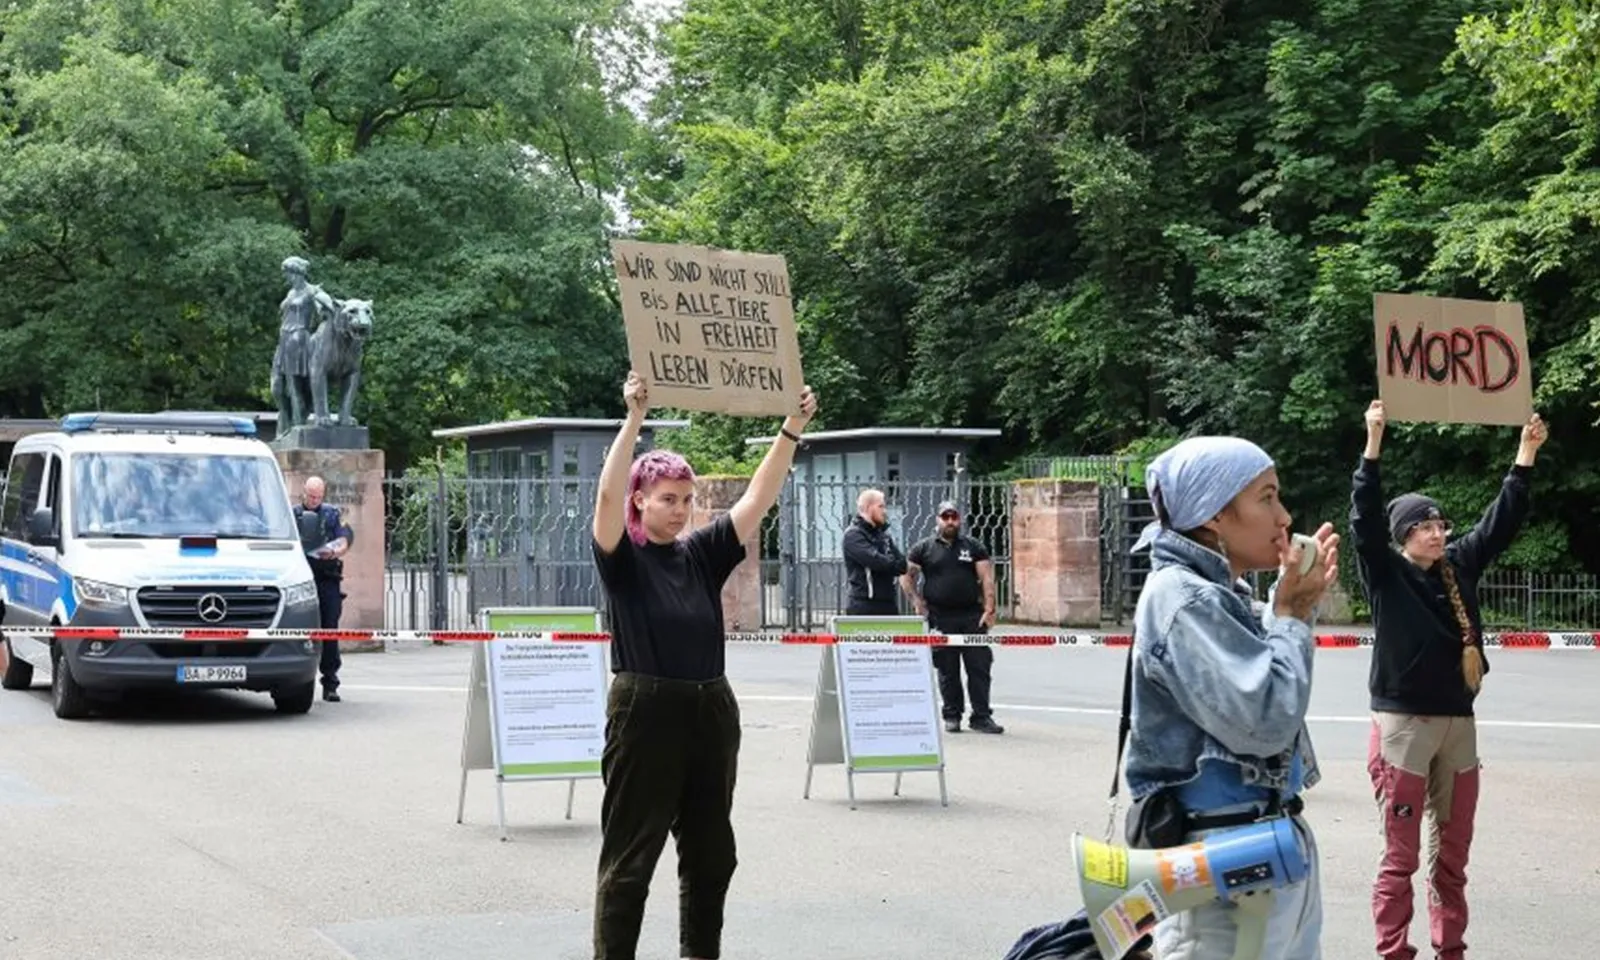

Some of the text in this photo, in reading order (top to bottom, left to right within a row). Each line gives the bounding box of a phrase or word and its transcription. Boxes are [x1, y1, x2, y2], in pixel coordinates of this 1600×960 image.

[622, 252, 658, 280] WIR
[666, 258, 701, 283] SIND
[708, 263, 747, 291] NICHT
[640, 288, 772, 324] BIS ALLE TIERE
[654, 316, 779, 350] IN FREIHEIT
[649, 351, 784, 392] LEBEN DÜRFEN
[1386, 320, 1520, 393] MORD
